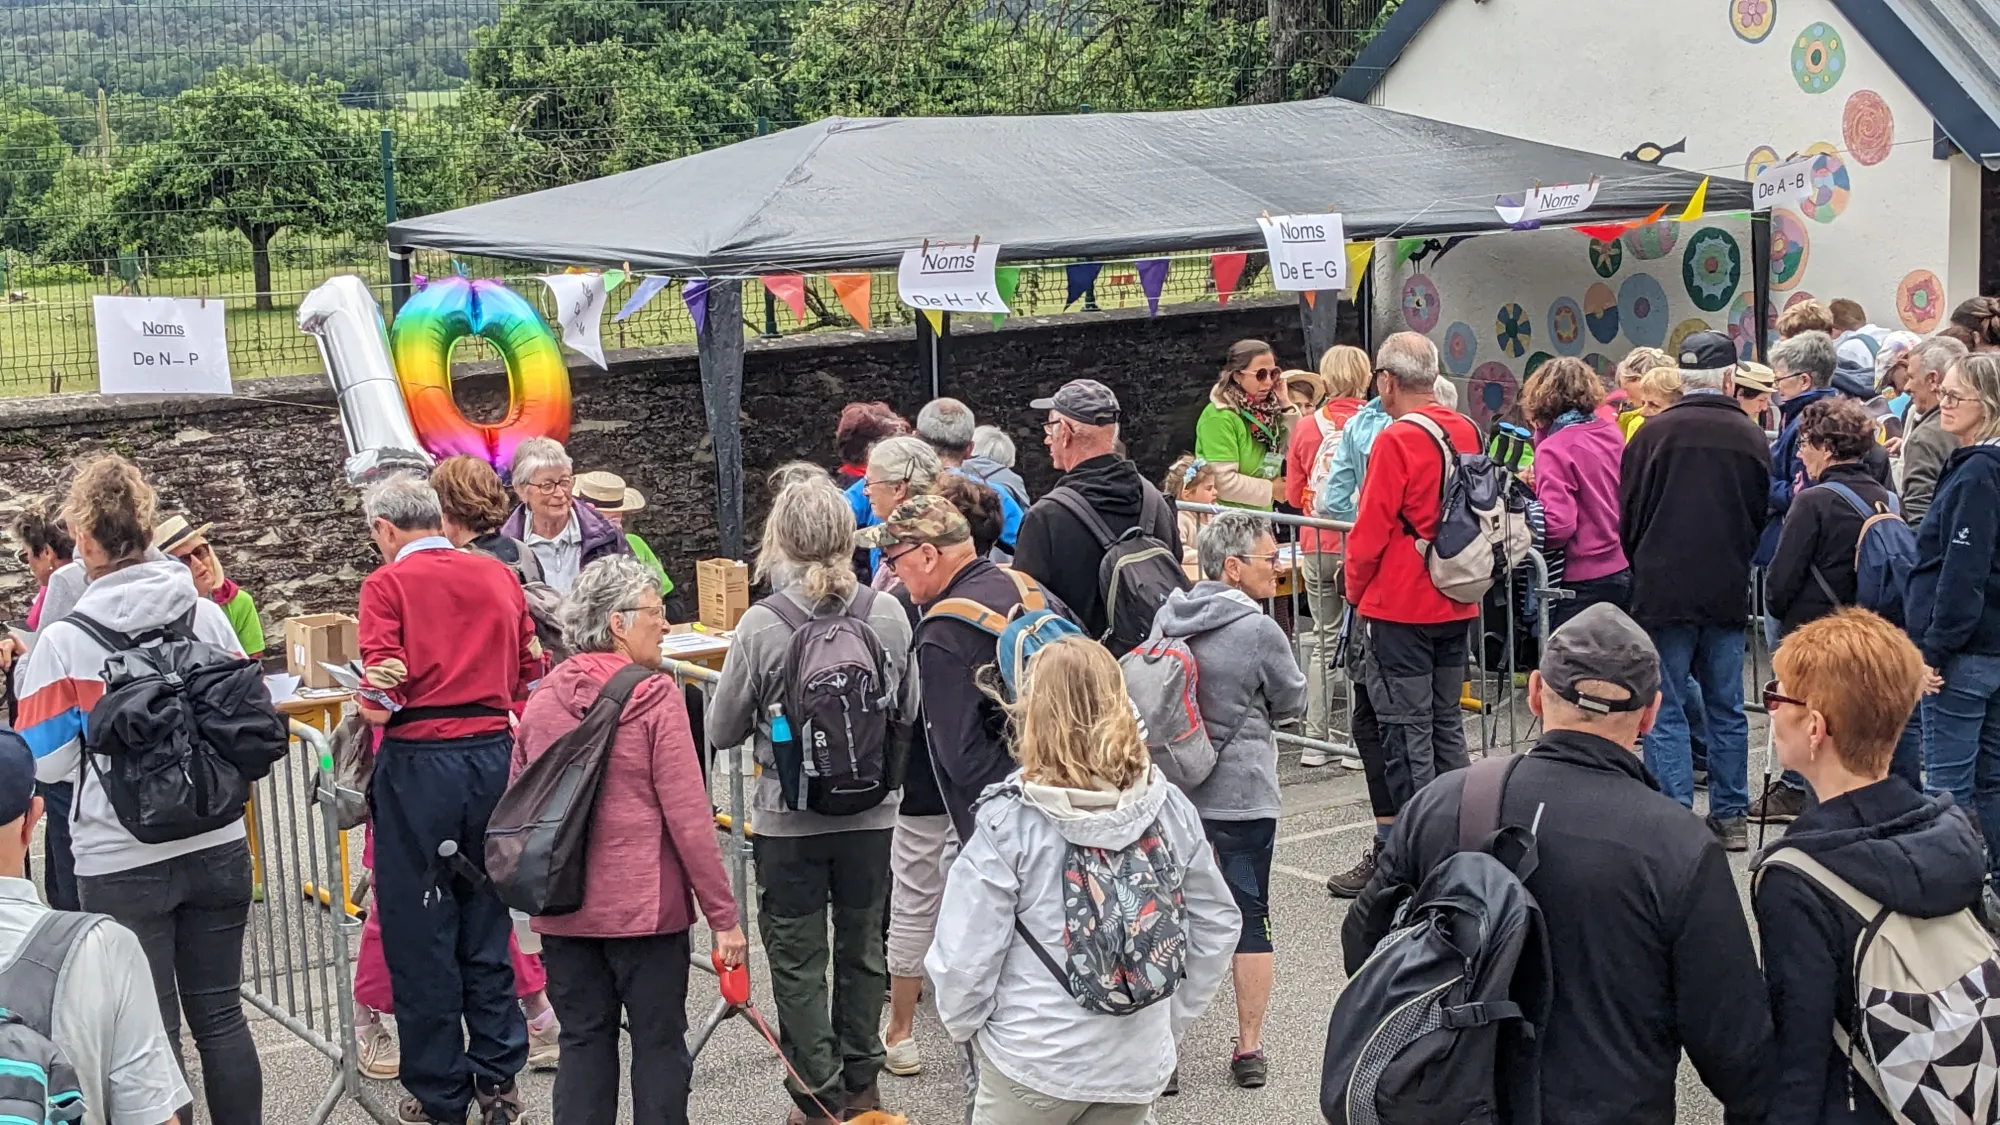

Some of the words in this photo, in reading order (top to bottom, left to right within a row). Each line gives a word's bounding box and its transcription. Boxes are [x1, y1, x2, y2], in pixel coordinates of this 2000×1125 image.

[1758, 179, 1775, 199] De
[1537, 192, 1581, 212] Noms
[1279, 221, 1326, 244] Noms
[920, 253, 976, 275] Noms
[1280, 261, 1299, 280] De
[912, 295, 943, 307] De
[142, 320, 185, 337] Noms
[133, 351, 155, 366] De
[813, 730, 828, 748] 20
